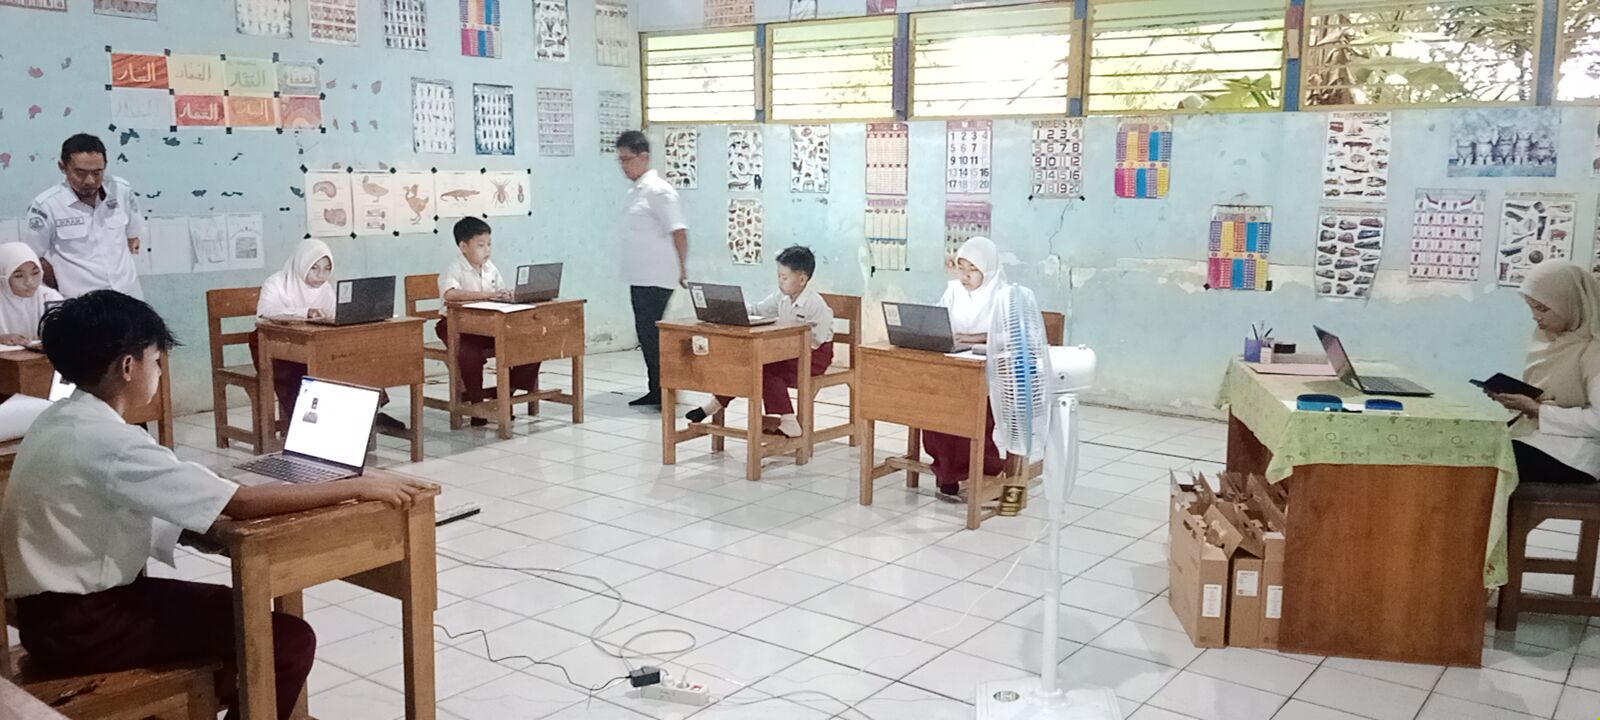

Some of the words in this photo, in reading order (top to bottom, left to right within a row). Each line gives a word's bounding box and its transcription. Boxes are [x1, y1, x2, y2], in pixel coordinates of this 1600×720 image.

[961, 131, 967, 140] 2
[971, 131, 977, 140] 3
[1047, 130, 1054, 139] 2
[1060, 129, 1067, 139] 3
[1072, 130, 1080, 138] 4
[950, 144, 956, 152] 5
[960, 144, 966, 152] 6
[971, 144, 977, 152] 7
[1047, 143, 1054, 153] 6
[1060, 143, 1067, 153] 7
[1072, 143, 1079, 153] 8
[950, 156, 956, 165] 9
[959, 156, 968, 165] 10
[970, 156, 978, 165] 11
[1035, 157, 1041, 166] 9
[1046, 157, 1056, 166] 10
[1071, 156, 1080, 166] 12
[959, 168, 968, 176] 14
[980, 168, 990, 177] 16
[1045, 171, 1055, 179] 14
[1070, 170, 1079, 179] 16
[949, 180, 957, 188] 17
[979, 180, 989, 189] 20
[1032, 184, 1042, 193] 17
[1057, 184, 1067, 193] 19
[1069, 184, 1080, 193] 20
